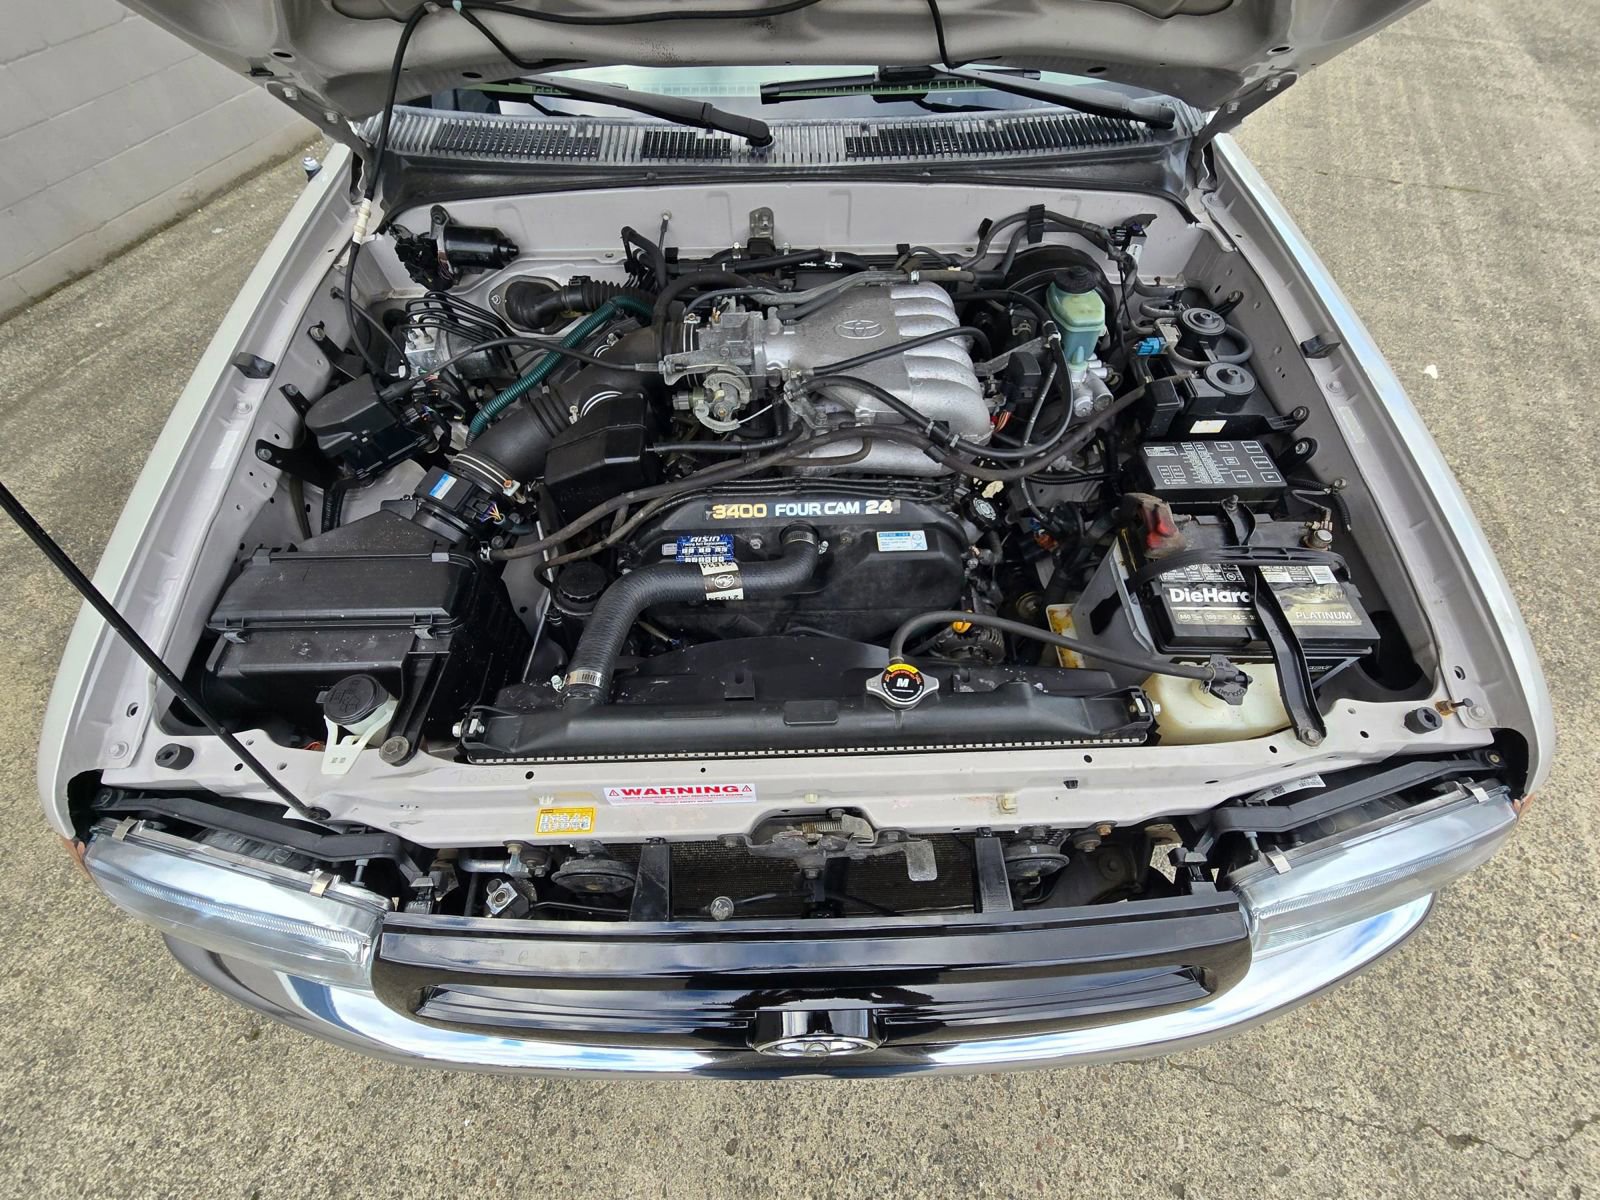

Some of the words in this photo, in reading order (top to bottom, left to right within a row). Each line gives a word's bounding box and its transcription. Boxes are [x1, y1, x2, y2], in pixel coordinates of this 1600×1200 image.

[712, 503, 767, 520] 3400
[775, 502, 822, 517] FOUR
[824, 501, 860, 515] CAM
[865, 499, 893, 514] 24
[1295, 611, 1353, 620] PLATINUM
[896, 678, 910, 687] M
[620, 785, 739, 796] WARNING
